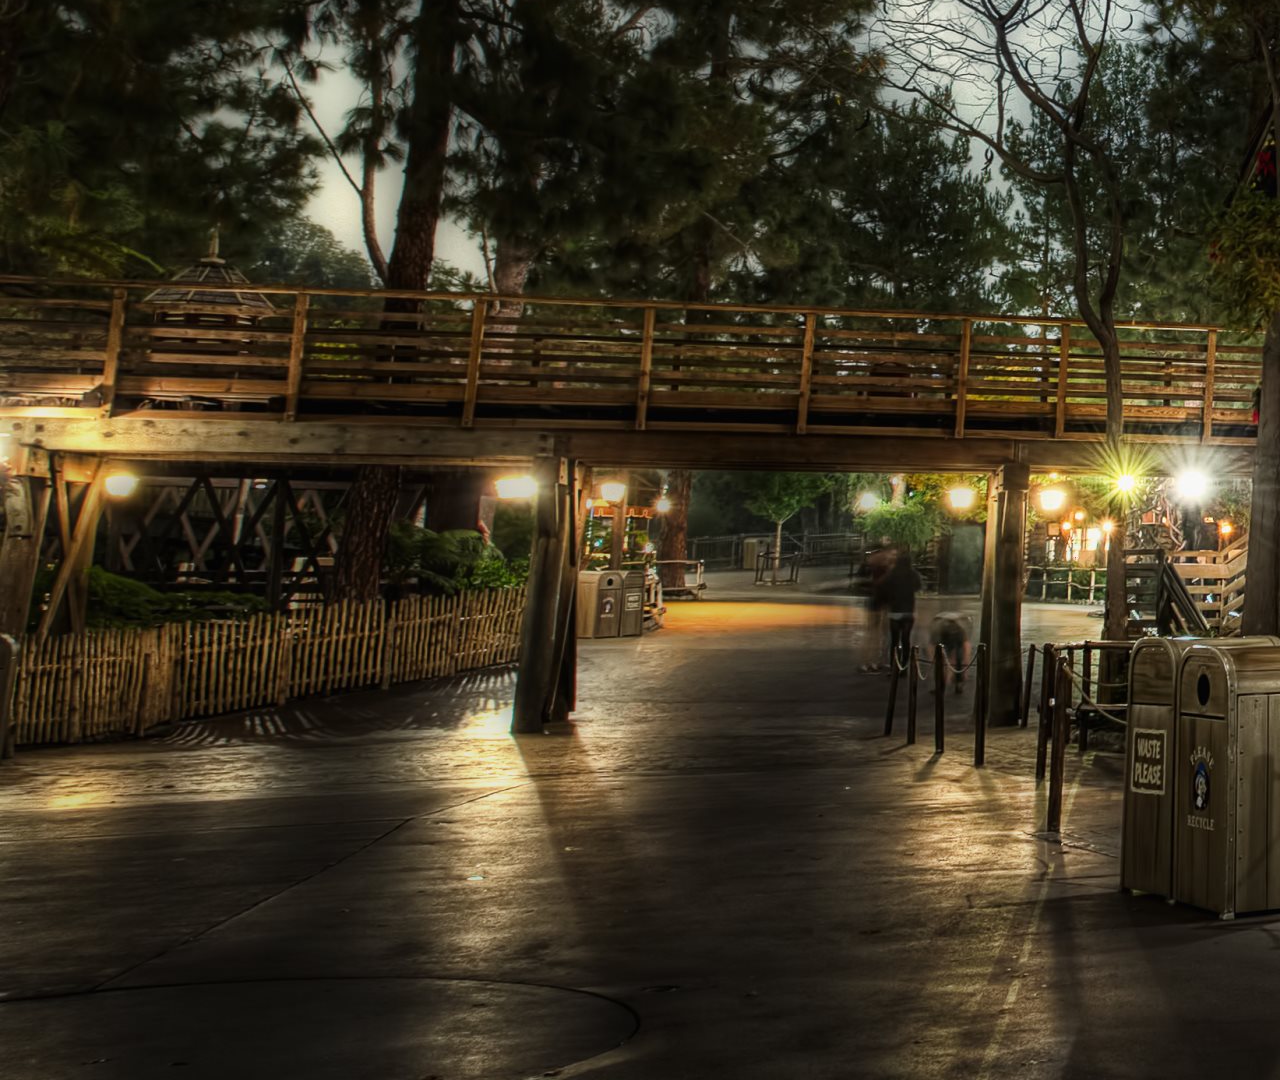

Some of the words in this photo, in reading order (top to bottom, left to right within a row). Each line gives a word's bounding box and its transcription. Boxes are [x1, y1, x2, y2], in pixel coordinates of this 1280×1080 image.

[1137, 738, 1161, 759] WASTE
[1190, 746, 1215, 770] PLEASE
[1135, 762, 1162, 785] PLEASE
[1187, 815, 1215, 831] RECYCLE
